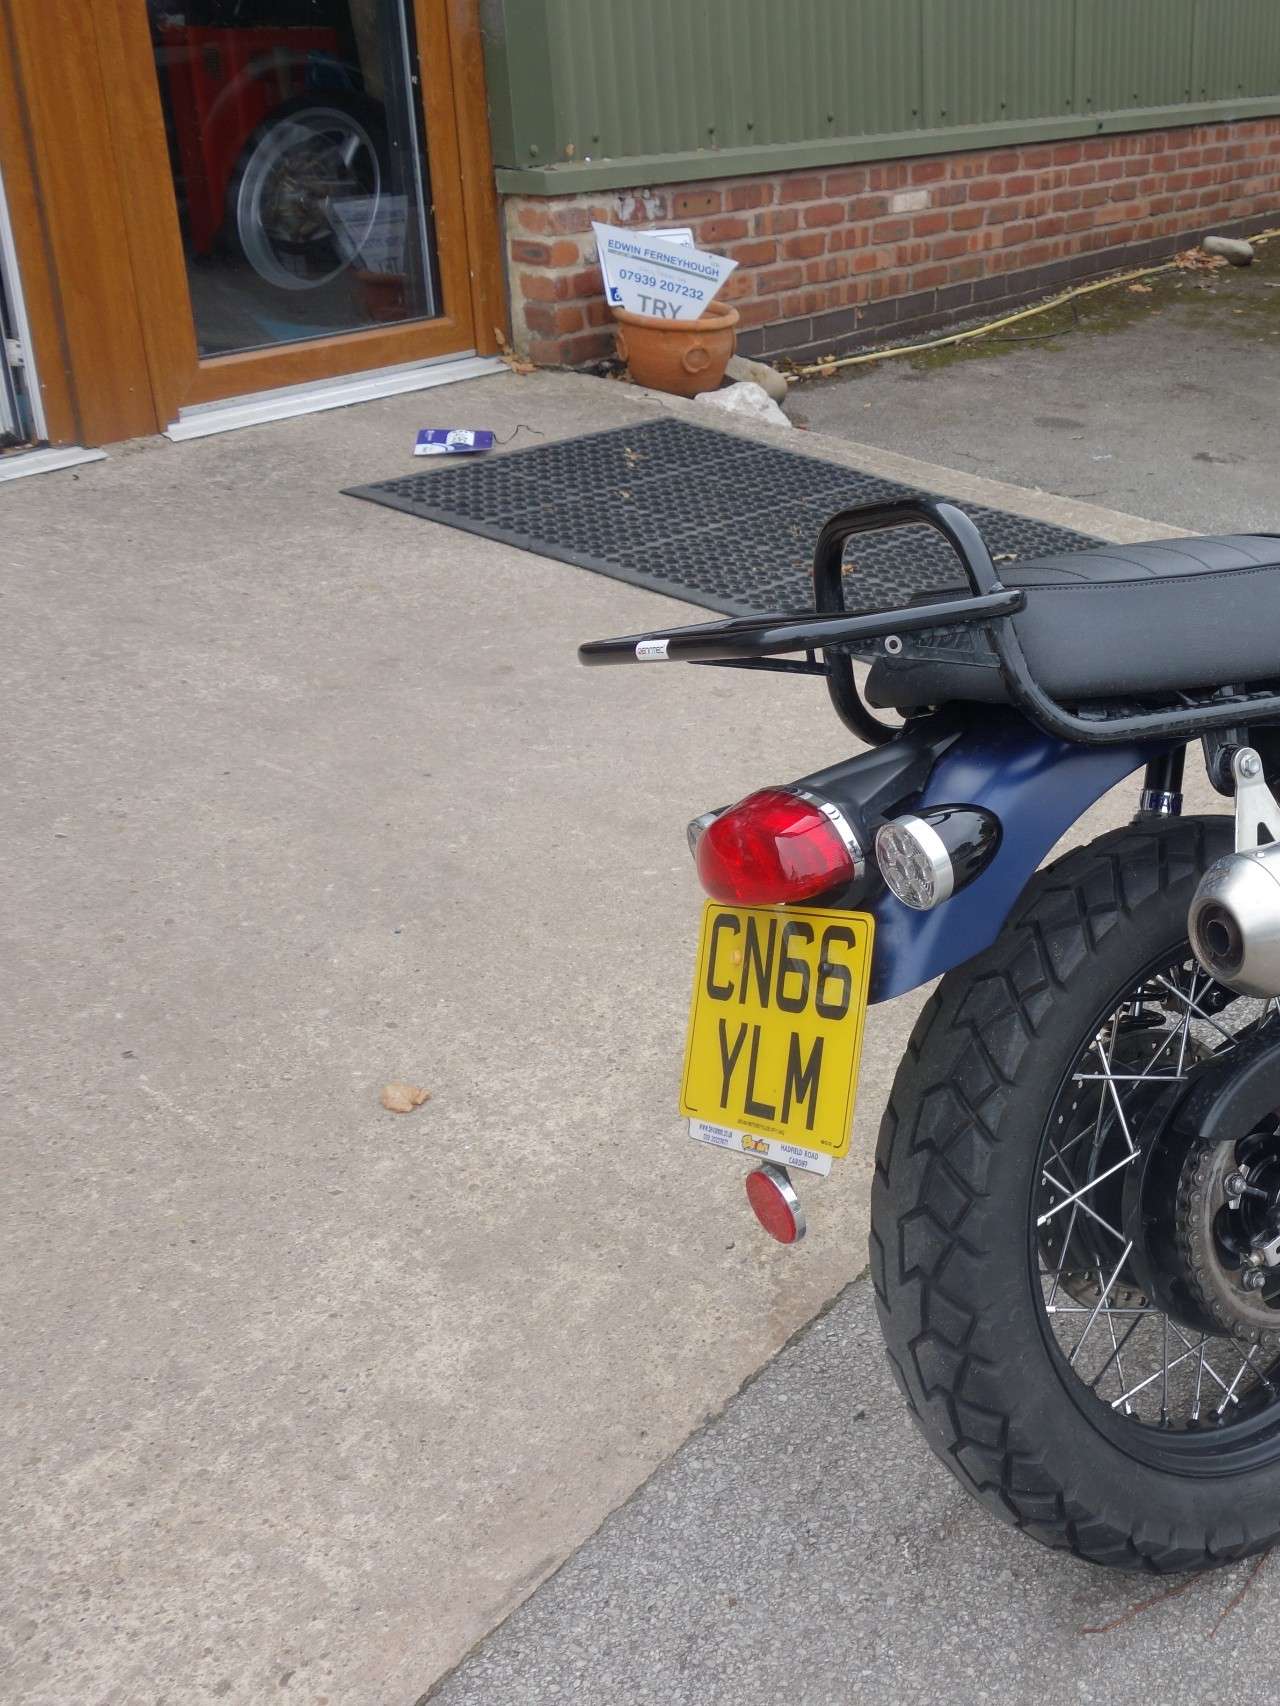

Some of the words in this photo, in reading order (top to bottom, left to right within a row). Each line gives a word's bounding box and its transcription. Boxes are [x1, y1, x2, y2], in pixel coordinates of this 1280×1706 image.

[607, 239, 641, 255] EDWIN
[643, 249, 720, 277] FERNEYHOUGH
[619, 268, 657, 287] 07939
[660, 279, 704, 301] 207232
[637, 294, 683, 319] TRY
[706, 913, 856, 1021] CN66
[718, 1018, 825, 1131] YLM
